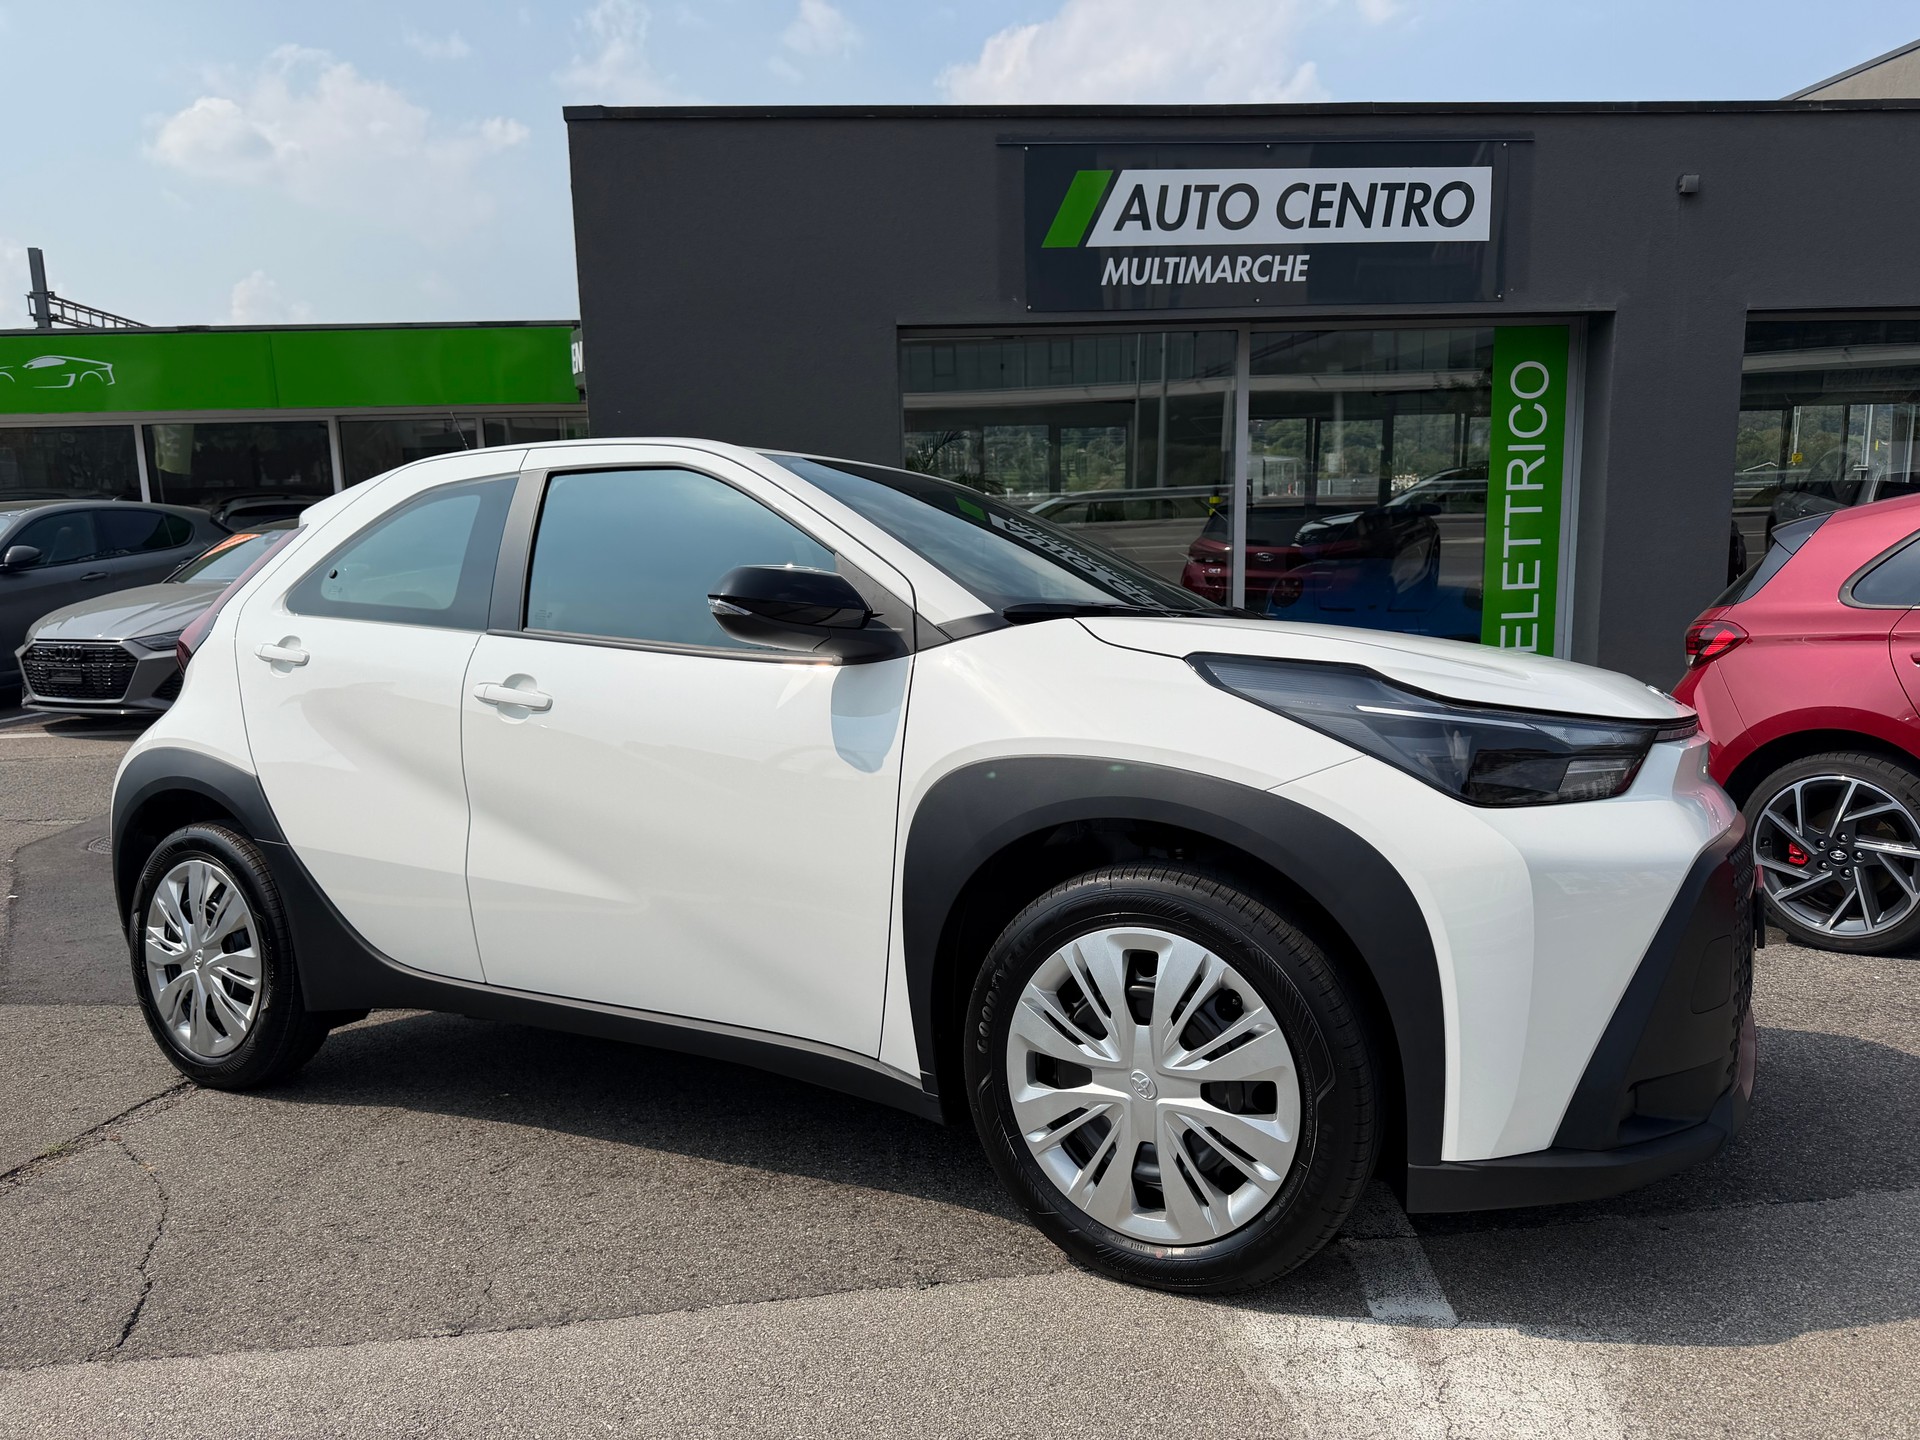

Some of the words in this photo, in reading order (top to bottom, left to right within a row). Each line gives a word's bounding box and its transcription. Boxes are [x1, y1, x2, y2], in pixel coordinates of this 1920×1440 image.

[1113, 182, 1260, 232] AUTO
[1276, 180, 1476, 230] CENTRO
[1101, 253, 1310, 286] MULTIMARCHE
[1500, 360, 1550, 653] ELETTRICO
